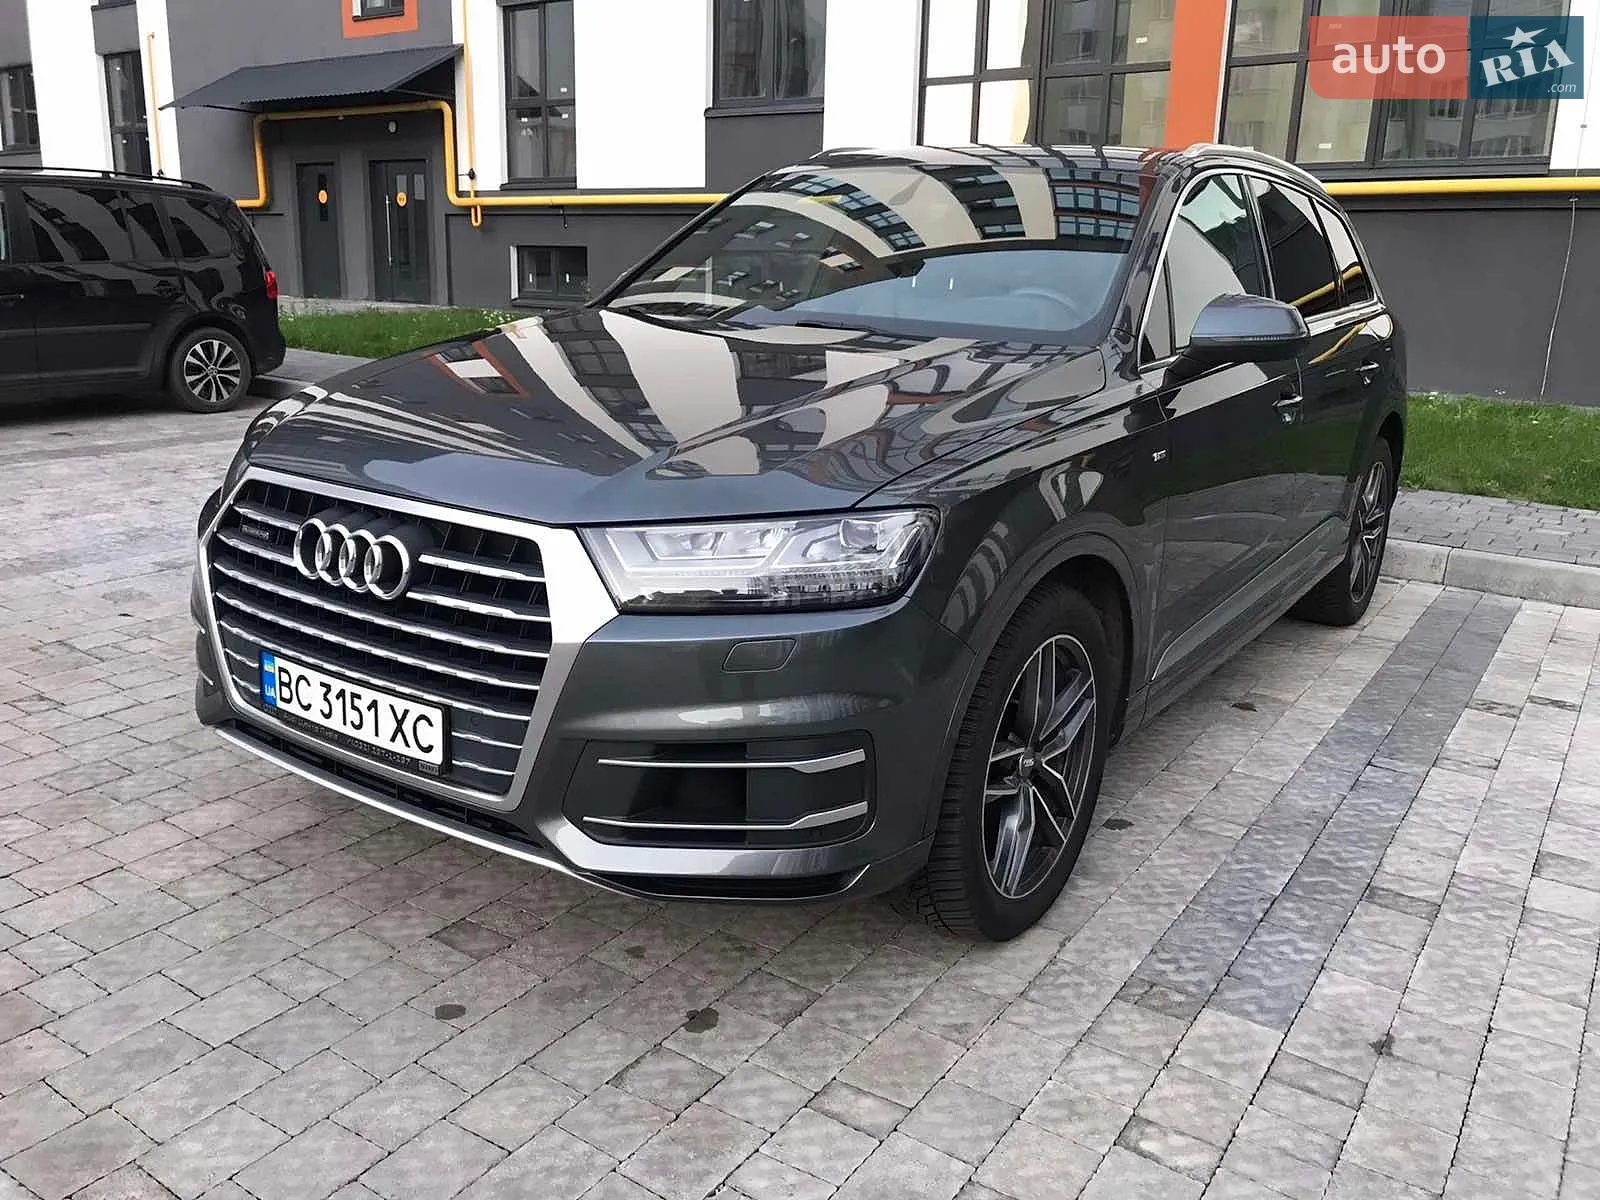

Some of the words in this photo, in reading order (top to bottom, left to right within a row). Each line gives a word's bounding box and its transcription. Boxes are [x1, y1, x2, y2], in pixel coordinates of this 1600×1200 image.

[264, 684, 276, 699] UA
[278, 666, 312, 712] BC
[319, 681, 379, 738] 3151
[389, 703, 434, 754] XC
